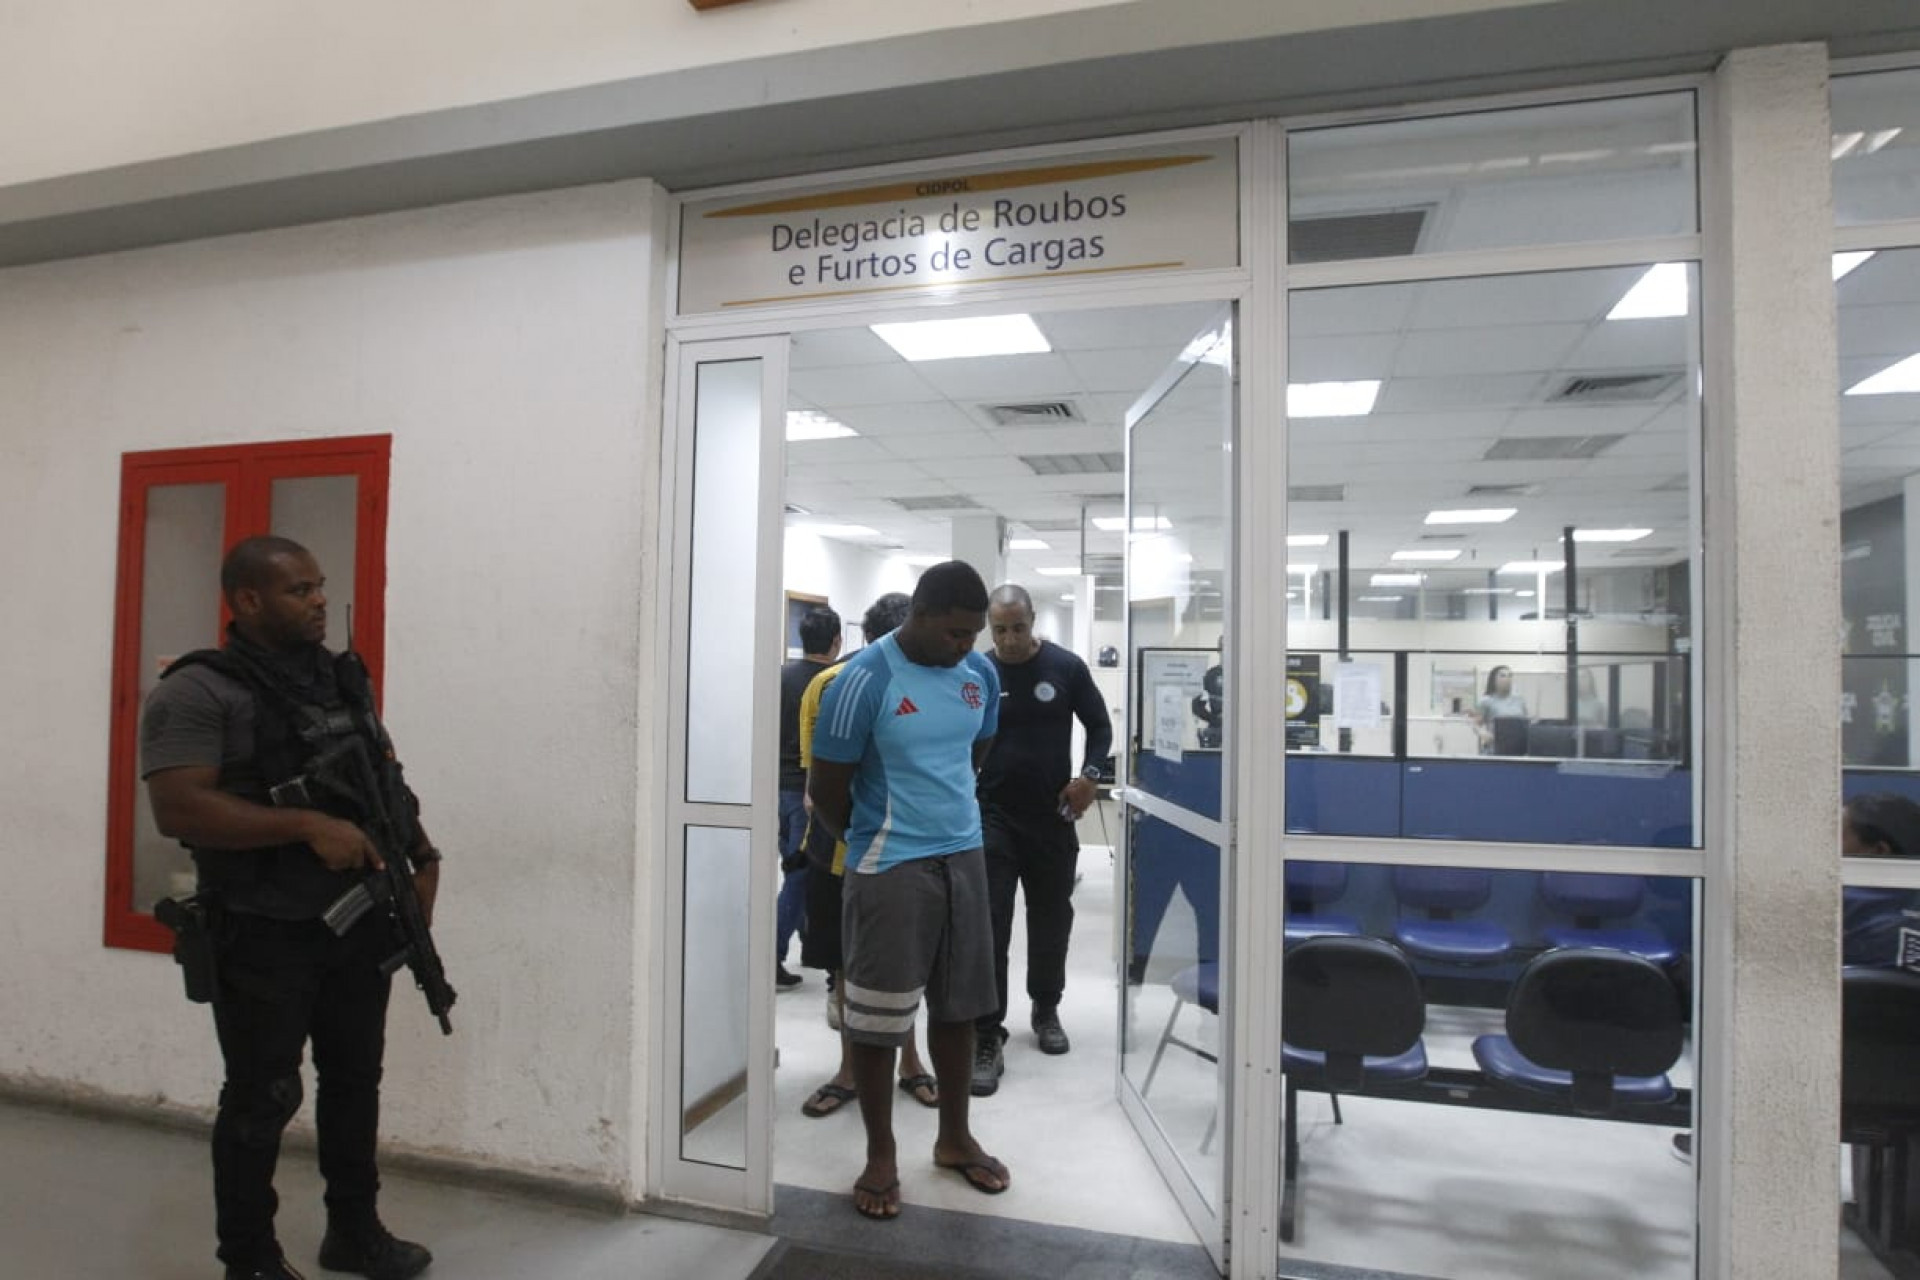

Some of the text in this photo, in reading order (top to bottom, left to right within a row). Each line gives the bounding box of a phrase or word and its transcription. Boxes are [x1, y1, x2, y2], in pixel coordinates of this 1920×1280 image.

[915, 179, 970, 196] CIDPOL
[772, 191, 1126, 252] Delegacia de Roubos
[788, 234, 1105, 285] e Furtos de Cargas
